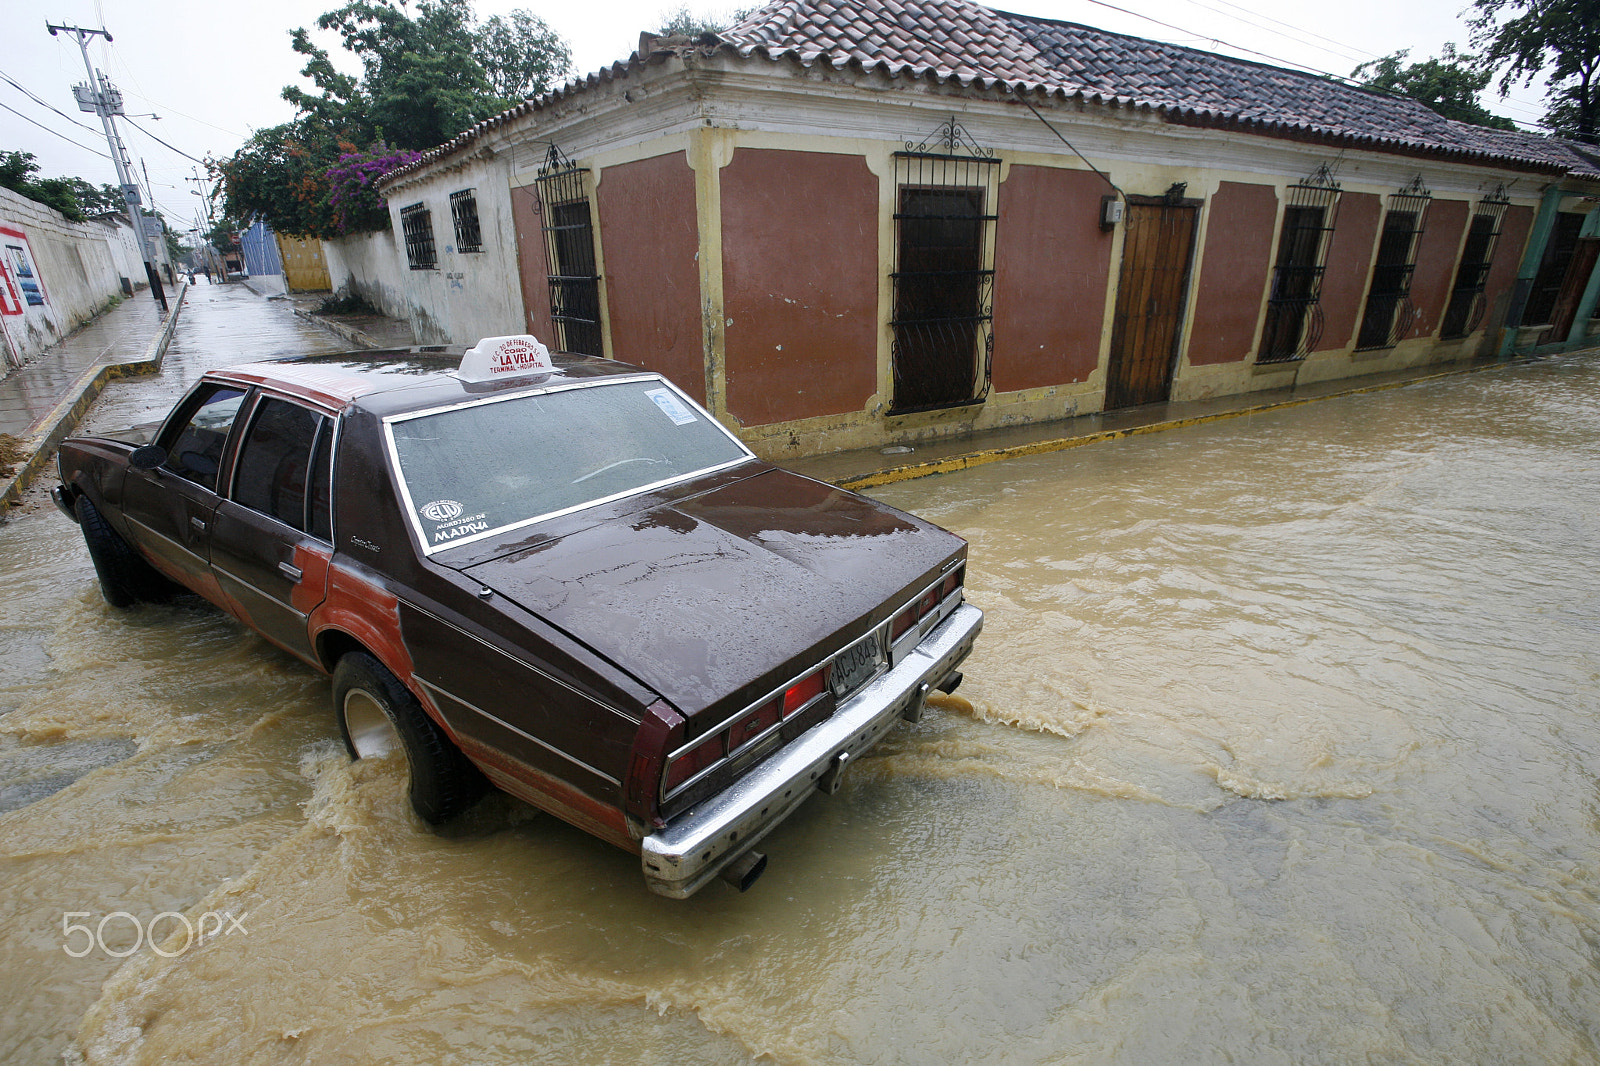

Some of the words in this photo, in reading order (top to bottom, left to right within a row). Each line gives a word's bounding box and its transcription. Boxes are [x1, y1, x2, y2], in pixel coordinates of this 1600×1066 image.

[506, 339, 513, 347] DE
[504, 347, 527, 355] CORO
[500, 355, 512, 366] LA
[513, 352, 535, 364] VELA
